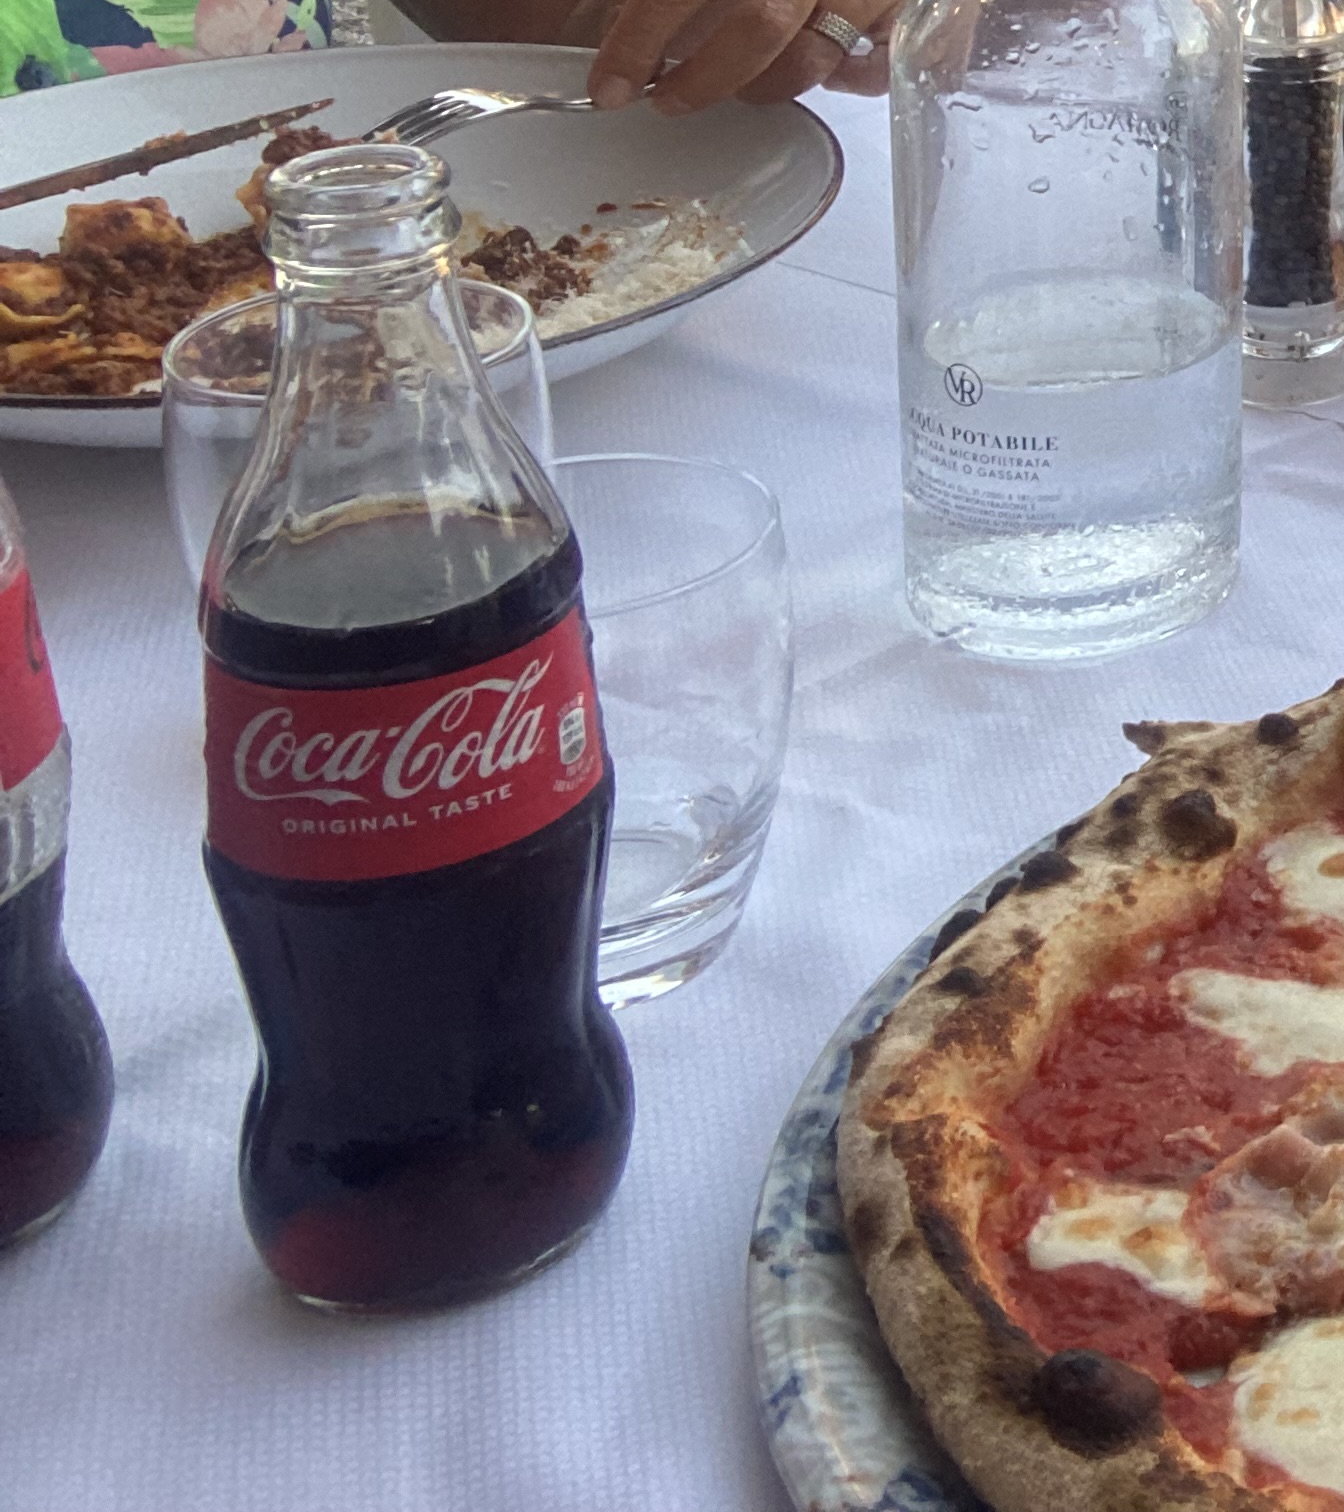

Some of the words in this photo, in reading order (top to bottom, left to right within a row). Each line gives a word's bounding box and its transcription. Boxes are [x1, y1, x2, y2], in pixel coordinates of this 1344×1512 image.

[951, 426, 1060, 452] POTABILE
[950, 448, 1050, 468] MICROFILTRATA
[962, 463, 973, 475] O
[977, 466, 1041, 482] GASSATA
[234, 650, 554, 807] Coca-Cola
[281, 812, 417, 836] ORIGINAL
[428, 783, 513, 820] TASTE
